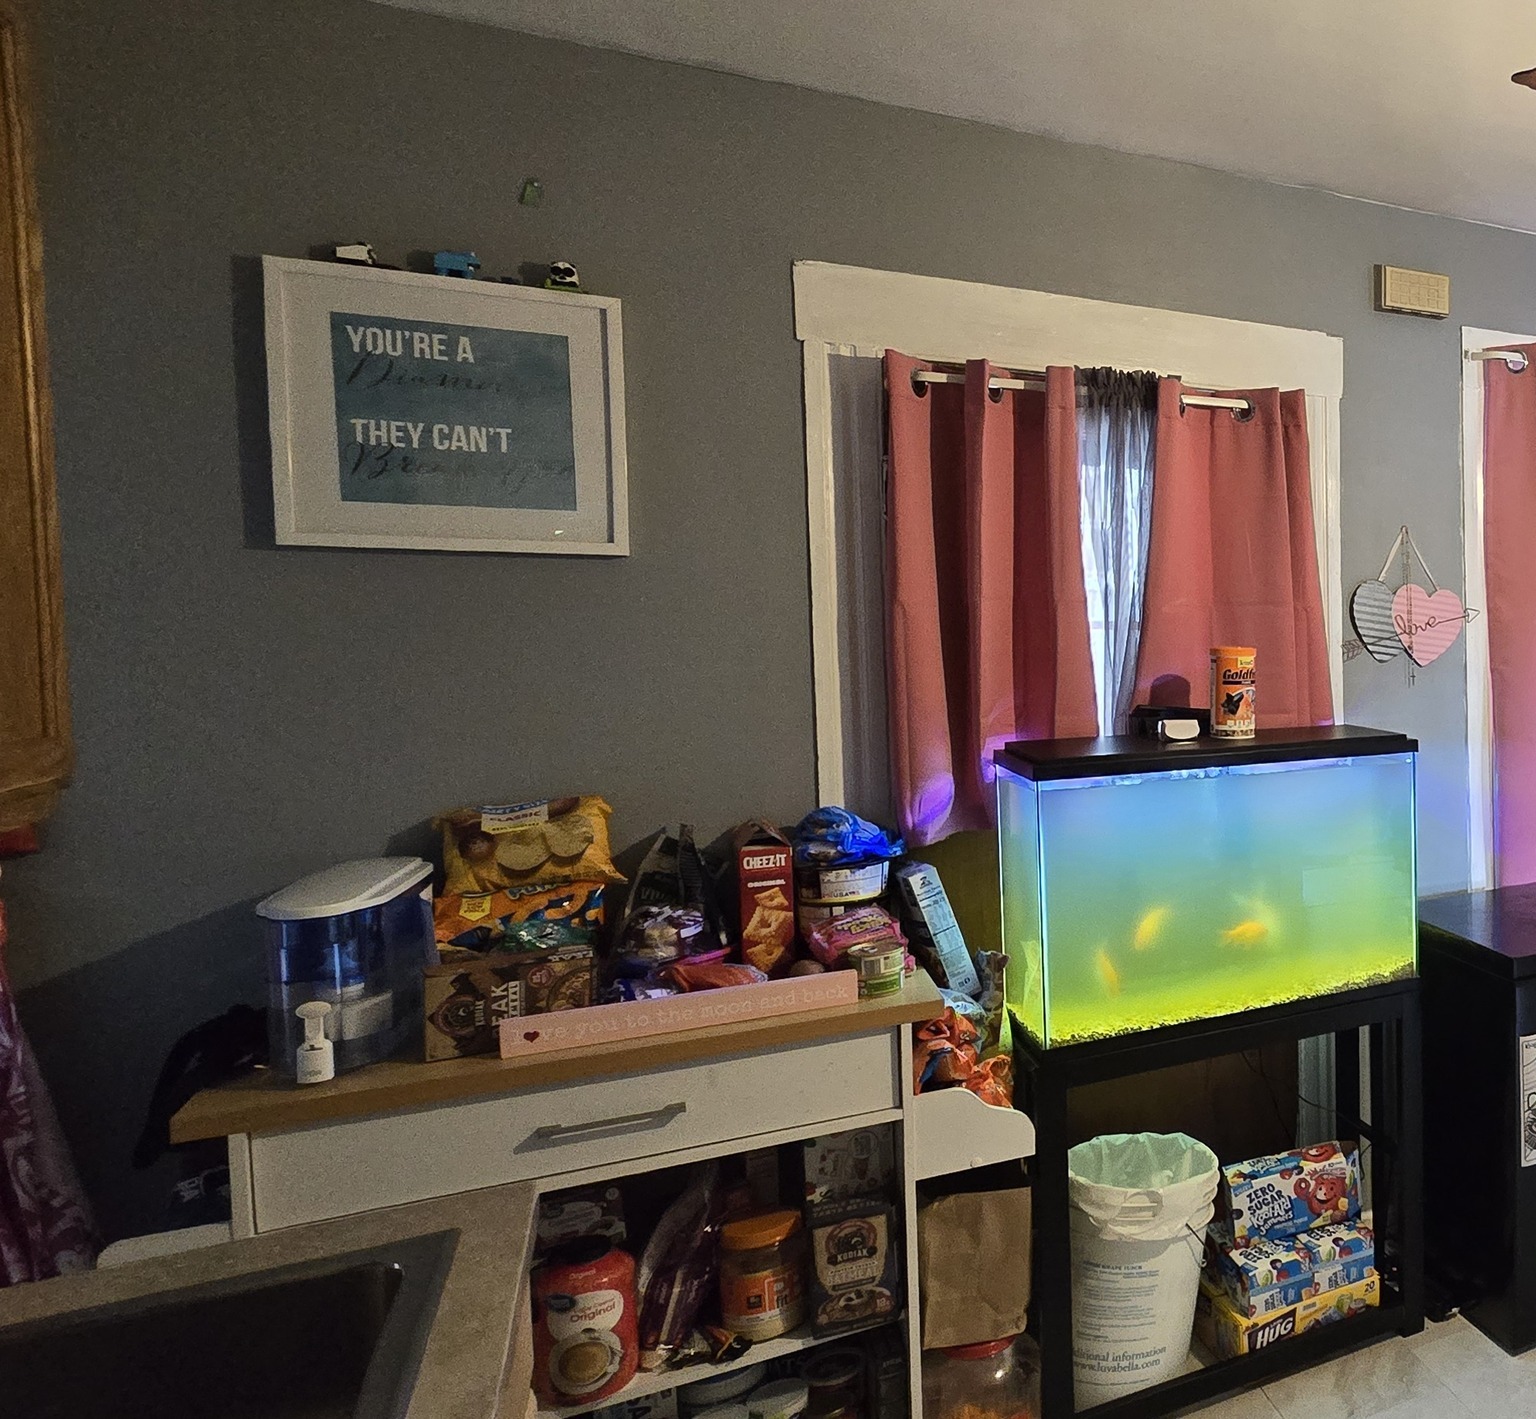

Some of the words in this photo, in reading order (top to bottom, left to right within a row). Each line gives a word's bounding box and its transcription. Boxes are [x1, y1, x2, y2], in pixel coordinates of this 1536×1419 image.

[345, 325, 448, 361] YOU'RE
[457, 336, 475, 363] A
[350, 418, 424, 449] THEY
[432, 423, 512, 453] CAN'T
[1395, 614, 1443, 636] love
[743, 853, 787, 871] CHEEZ-IT
[626, 1014, 652, 1029] to
[657, 1008, 693, 1025] the
[760, 992, 796, 1012] and
[804, 984, 848, 1004] back
[1246, 1183, 1275, 1204] ZERO
[1247, 1190, 1286, 1215] SUGAR
[1250, 1196, 1292, 1228] Kool-Aid
[1260, 1211, 1293, 1235] Jammers
[836, 1248, 869, 1262] KODIAK
[570, 1300, 617, 1324] Original
[1256, 1316, 1294, 1350] HUG
[1112, 1345, 1167, 1363] information
